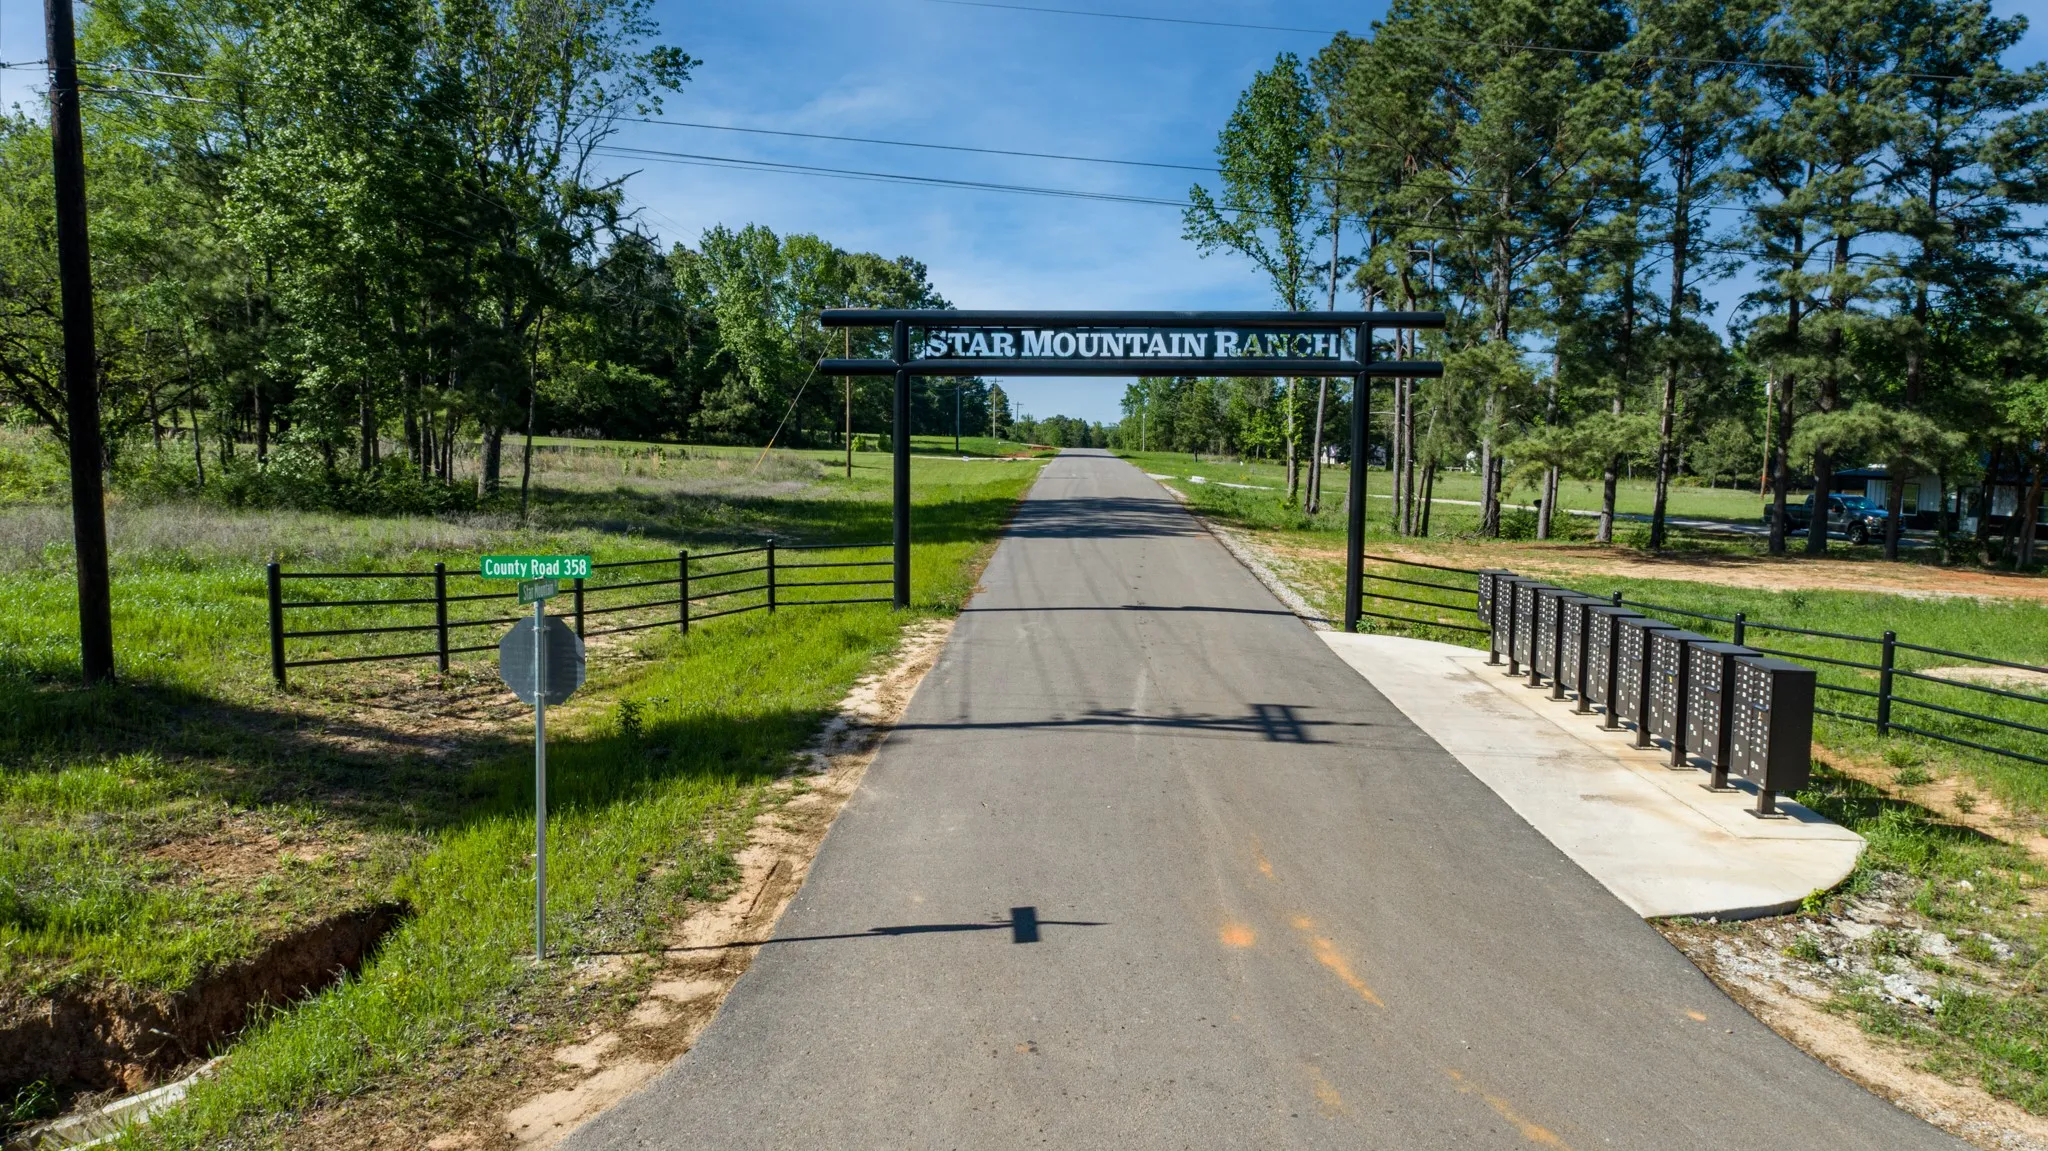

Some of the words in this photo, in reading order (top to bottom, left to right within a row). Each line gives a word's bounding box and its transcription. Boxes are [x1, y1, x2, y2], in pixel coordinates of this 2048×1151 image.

[925, 330, 1016, 357] STAR
[1021, 330, 1208, 357] MOUNTAIN
[1213, 331, 1340, 357] RANCH
[485, 559, 527, 577] County
[531, 559, 560, 576] Road
[564, 559, 587, 576] 358
